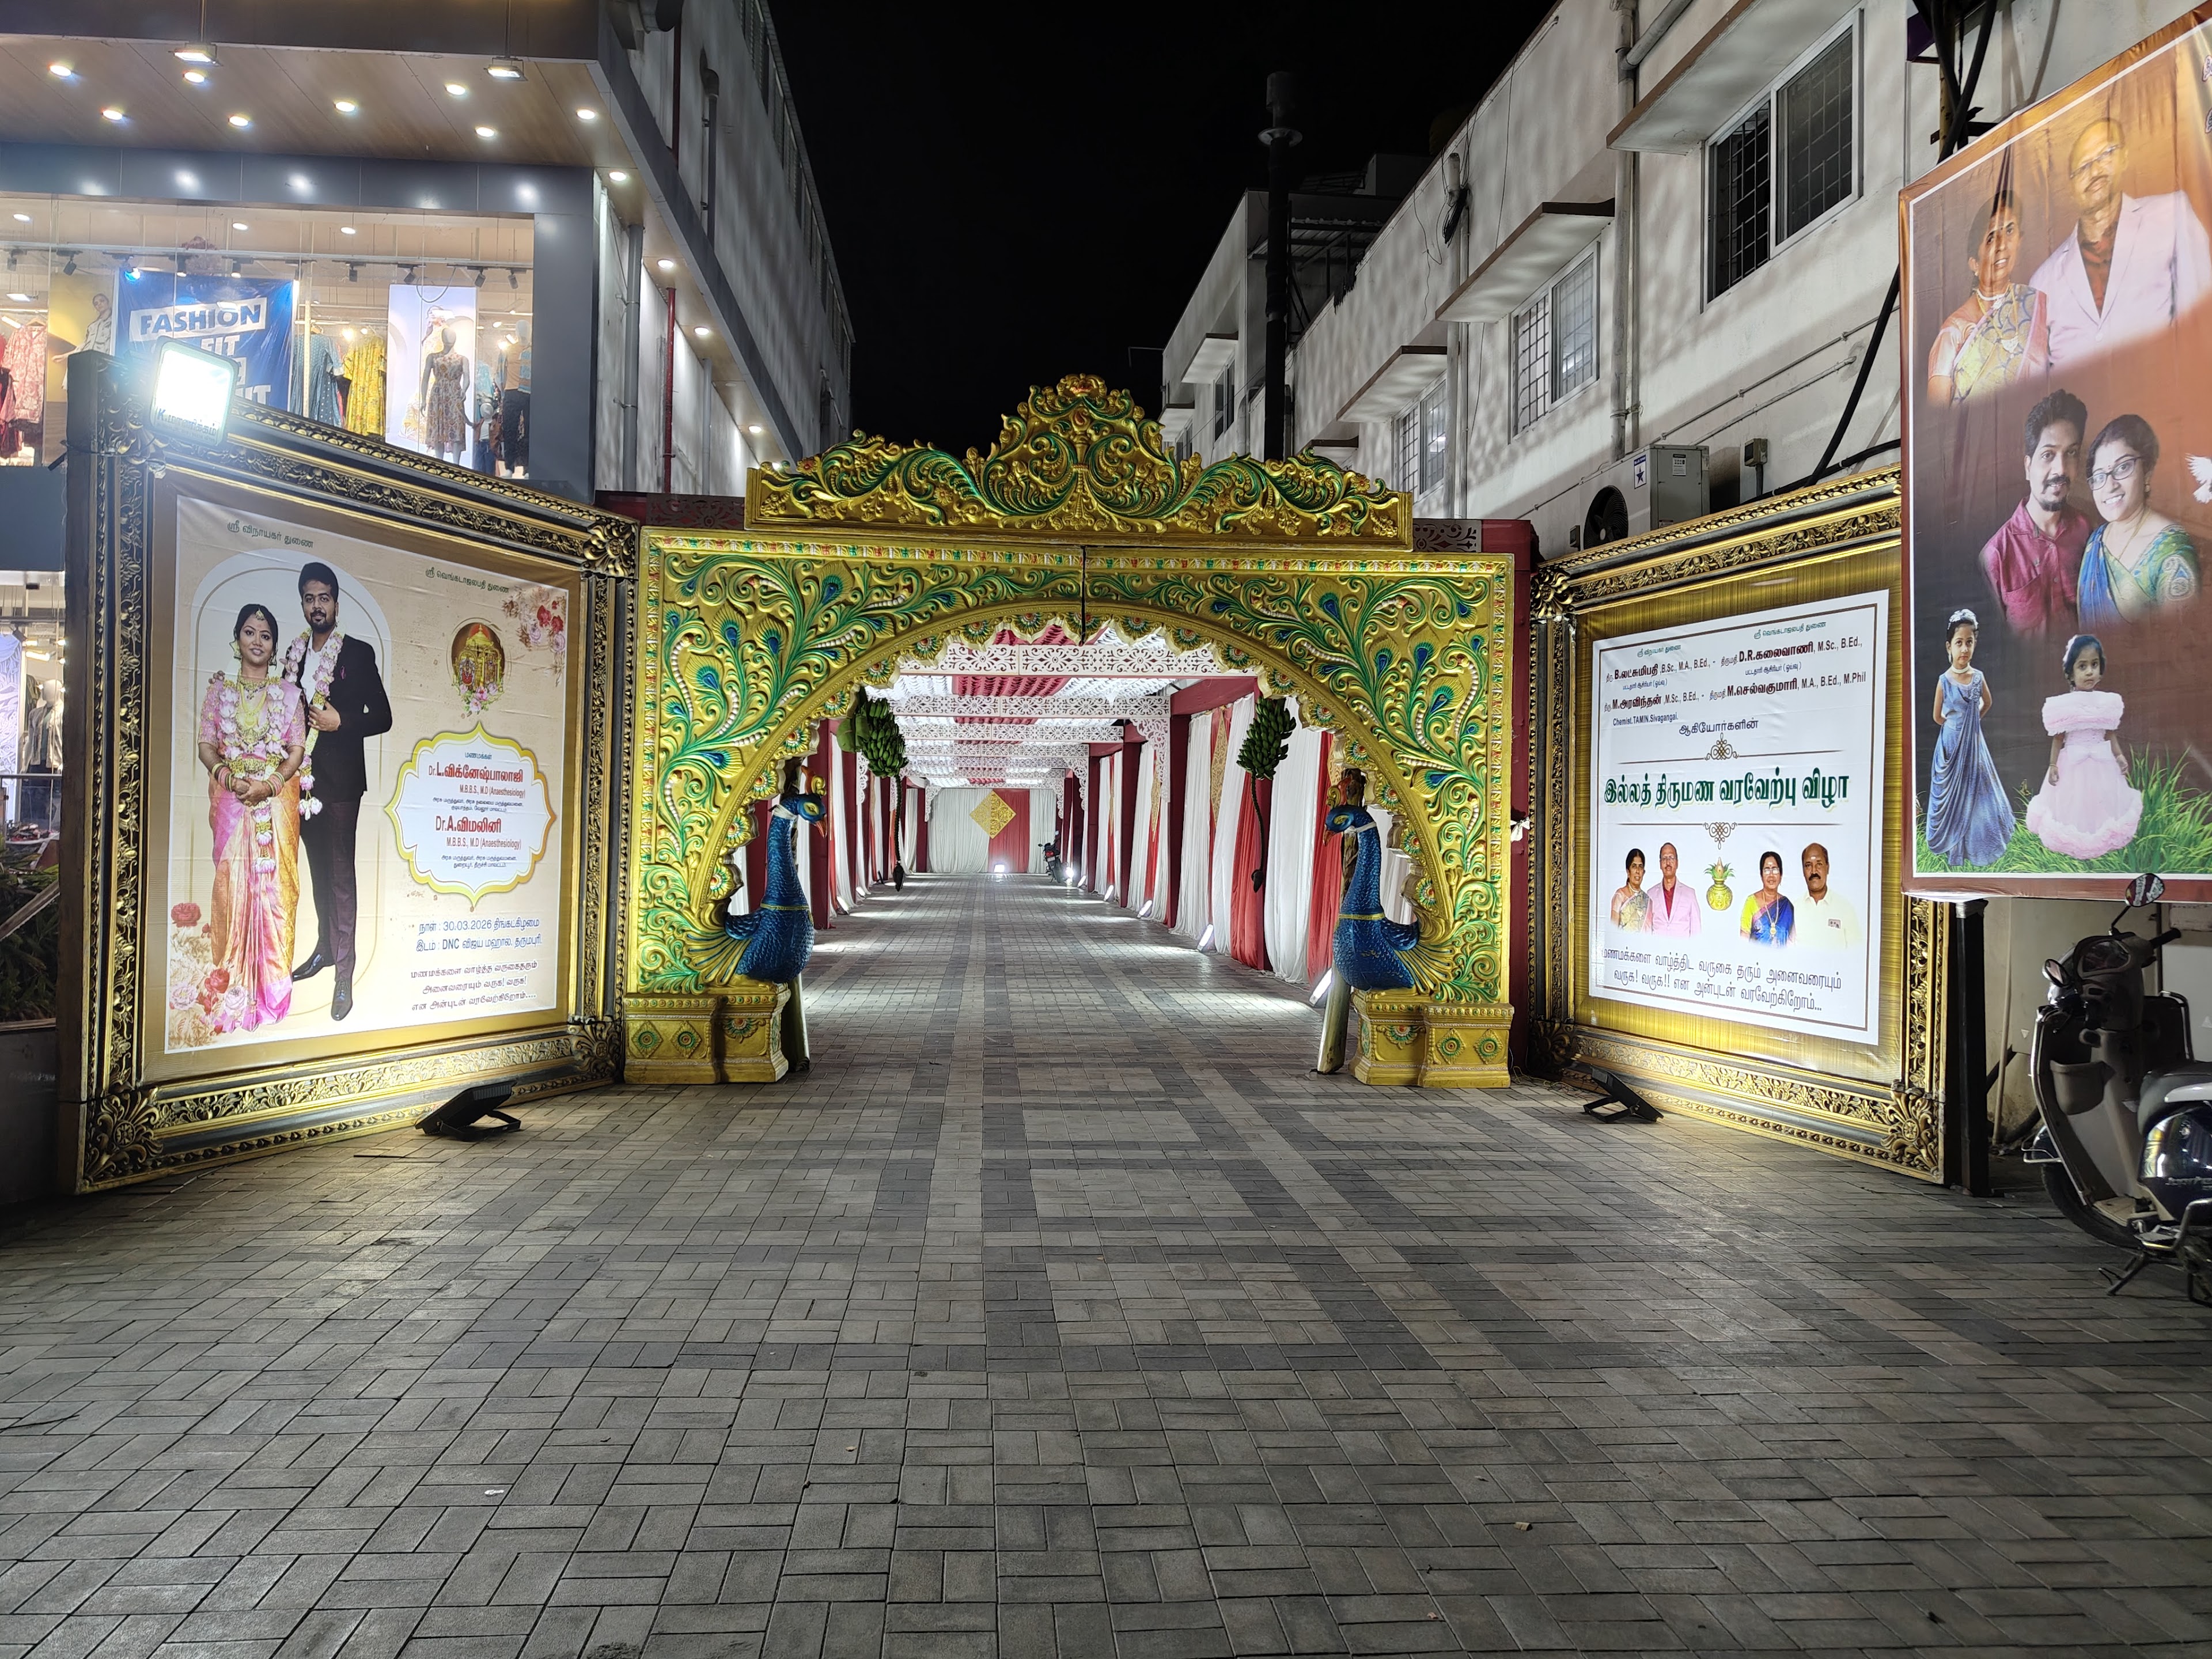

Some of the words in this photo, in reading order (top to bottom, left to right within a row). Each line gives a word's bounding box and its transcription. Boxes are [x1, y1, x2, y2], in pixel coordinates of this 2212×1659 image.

[141, 304, 260, 335] FASHION
[243, 525, 282, 541] விநாயகர்
[285, 536, 313, 548] துணை
[437, 571, 486, 590] வெங்கடாஜலபதி
[487, 583, 509, 593] துணை
[1805, 622, 1826, 631] துணை
[1843, 671, 1866, 684] M.Phil
[1679, 717, 1758, 736] ஆகியோர்களின்
[465, 752, 492, 760] மணமக்கள்
[489, 786, 525, 798] (Anaesthesiology)
[1604, 774, 1652, 808] இல்லத்
[1656, 774, 1715, 808] திருமண
[1719, 767, 1796, 809] வரவேற்பு
[1802, 767, 1849, 808] விழா
[480, 839, 521, 850] (Anaesthesiology)
[443, 920, 491, 931] 30.03.2026
[442, 938, 459, 949] DNC
[411, 968, 461, 978] மணமக்களை
[464, 964, 493, 974] வாழ்த்த
[1603, 946, 1651, 964] மணமக்களை
[1656, 952, 1694, 972] வாழ்த்திட
[1699, 961, 1732, 978] வருகை
[1737, 962, 1760, 982] தரும்
[1766, 968, 1841, 992] அனைவரையும்
[423, 980, 482, 994] அனைவரையும்
[483, 978, 504, 987] வருக!
[506, 976, 527, 986] வருக!
[1614, 969, 1638, 986] வருக!
[1642, 974, 1669, 990] வருக!!
[1674, 979, 1690, 990] என
[1694, 979, 1736, 999] அன்புடன்
[412, 1003, 427, 1011] என
[430, 998, 466, 1010] அன்புடன்
